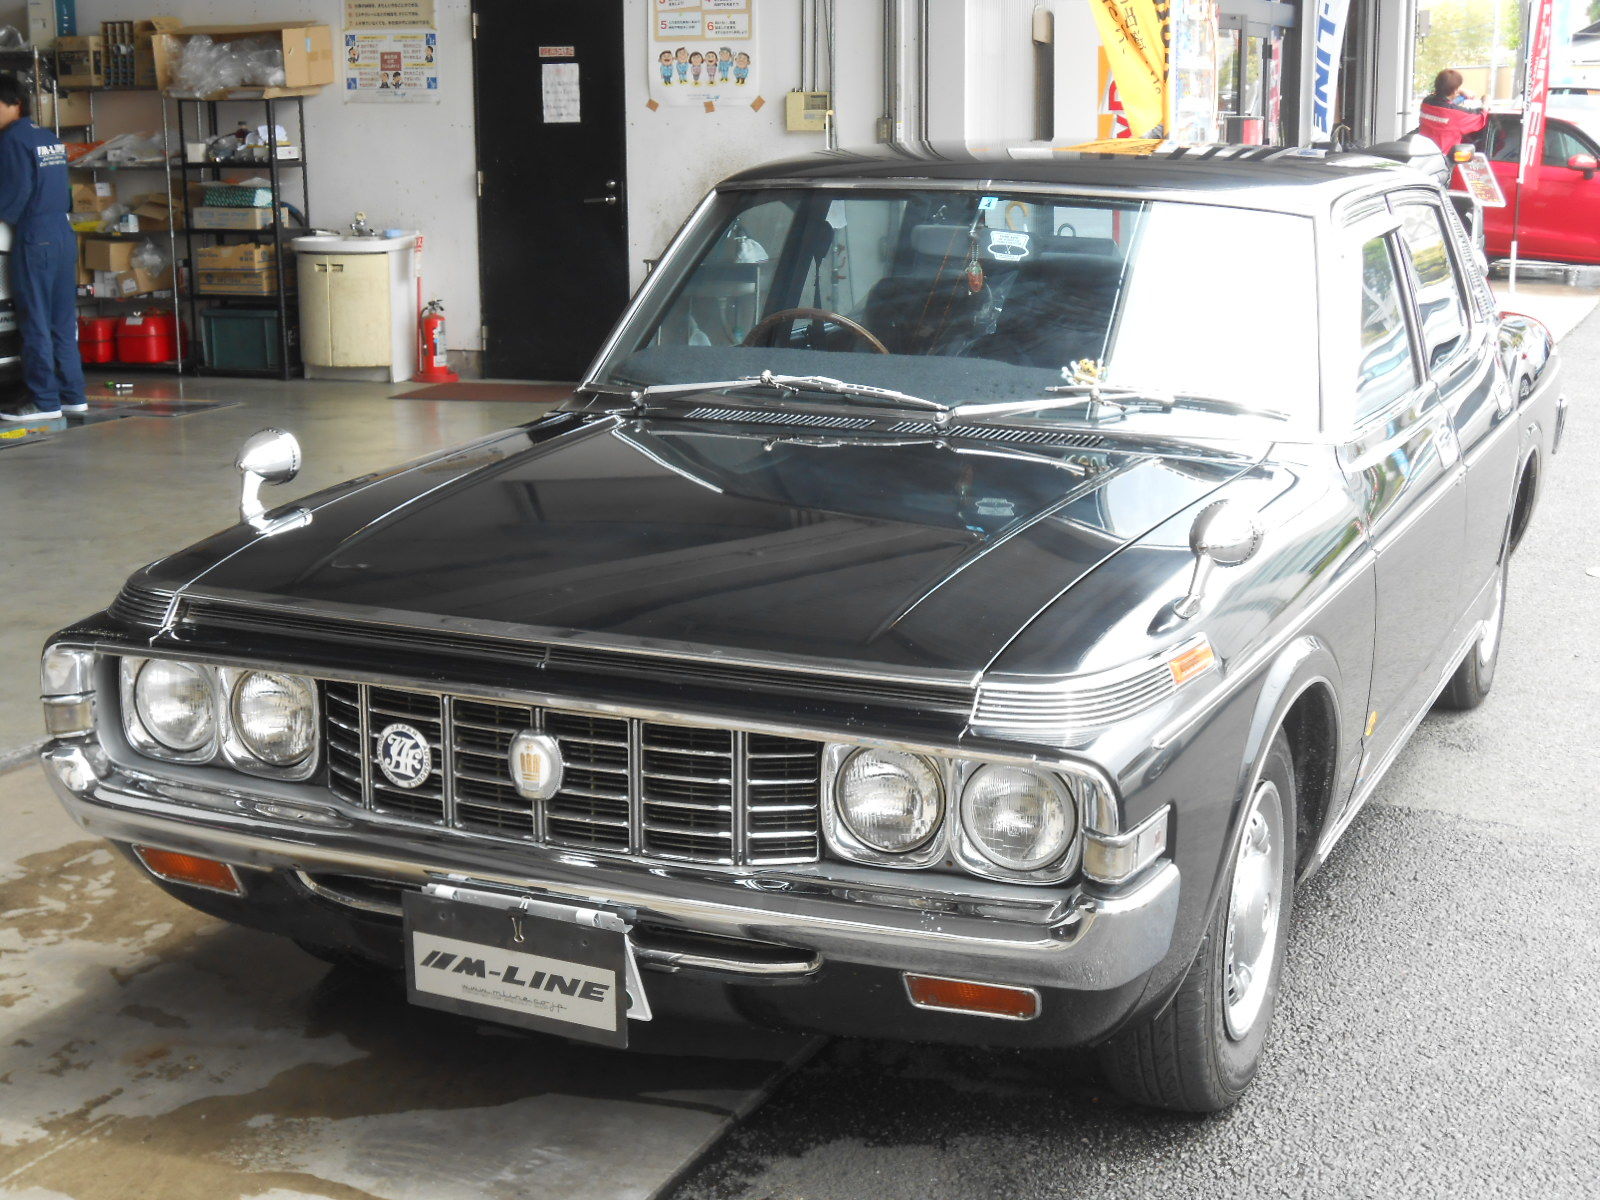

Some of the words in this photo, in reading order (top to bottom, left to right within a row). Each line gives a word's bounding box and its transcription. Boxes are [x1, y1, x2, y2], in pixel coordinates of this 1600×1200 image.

[660, 20, 668, 30] 5
[707, 21, 715, 31] 6
[391, 724, 418, 737] JAPAN
